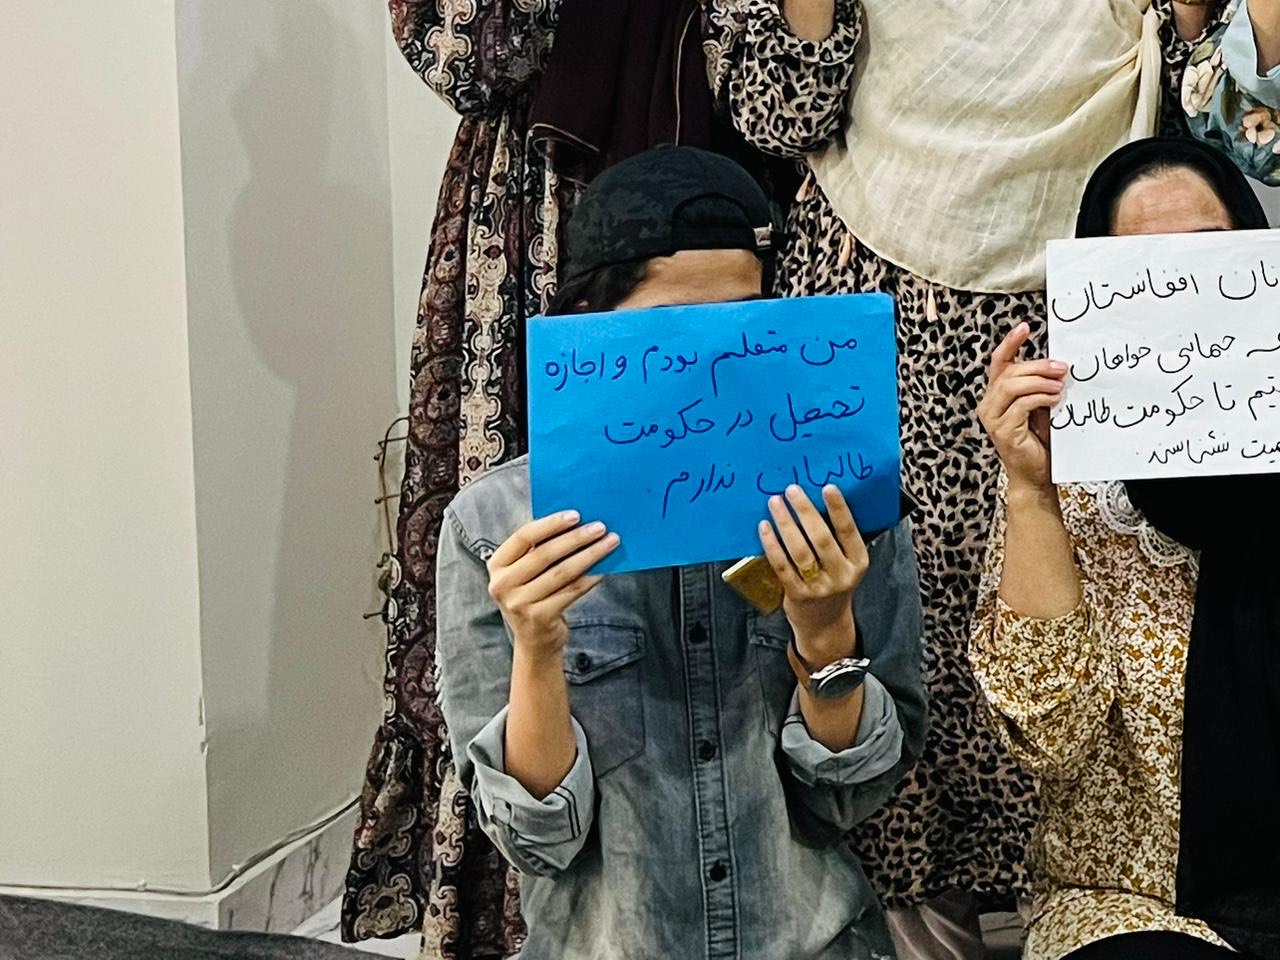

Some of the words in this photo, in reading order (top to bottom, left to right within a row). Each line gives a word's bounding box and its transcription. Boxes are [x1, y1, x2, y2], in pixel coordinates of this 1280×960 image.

[1052, 268, 1199, 322] افغانستان
[546, 349, 604, 391] اجازه
[612, 356, 627, 380] و
[643, 346, 697, 383] بودم
[711, 330, 787, 397] متعلم
[801, 338, 857, 366] من
[1069, 336, 1152, 382] خواهان
[1157, 333, 1236, 374] جهانی
[770, 386, 864, 441] تحصیل
[1050, 395, 1111, 433] طالبان
[1113, 375, 1204, 428] حکومت
[1213, 381, 1236, 411] تا
[605, 399, 715, 448] حکومت
[727, 410, 753, 436] در
